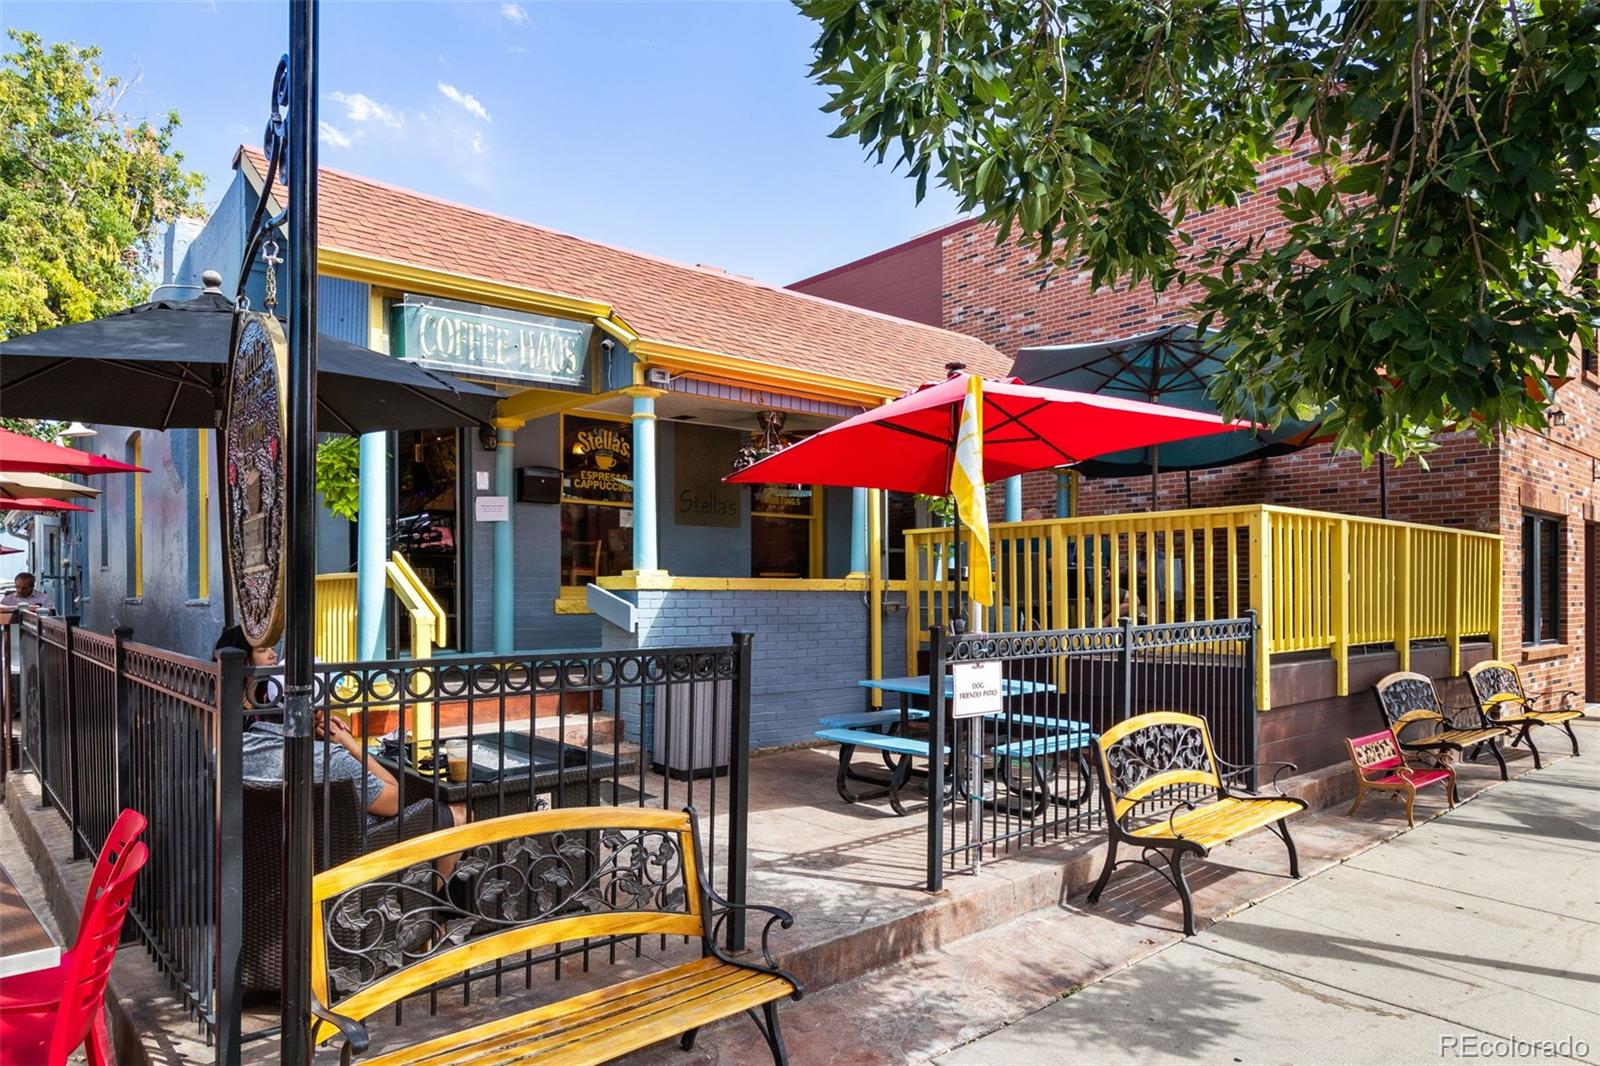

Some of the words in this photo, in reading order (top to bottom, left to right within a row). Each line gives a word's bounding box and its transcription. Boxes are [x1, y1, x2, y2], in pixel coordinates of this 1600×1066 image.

[419, 312, 511, 366] COFFEE
[519, 328, 577, 375] HAUS
[577, 430, 631, 459] Stella's
[580, 470, 628, 482] ESPRESSO
[959, 691, 982, 699] FRIENDLY
